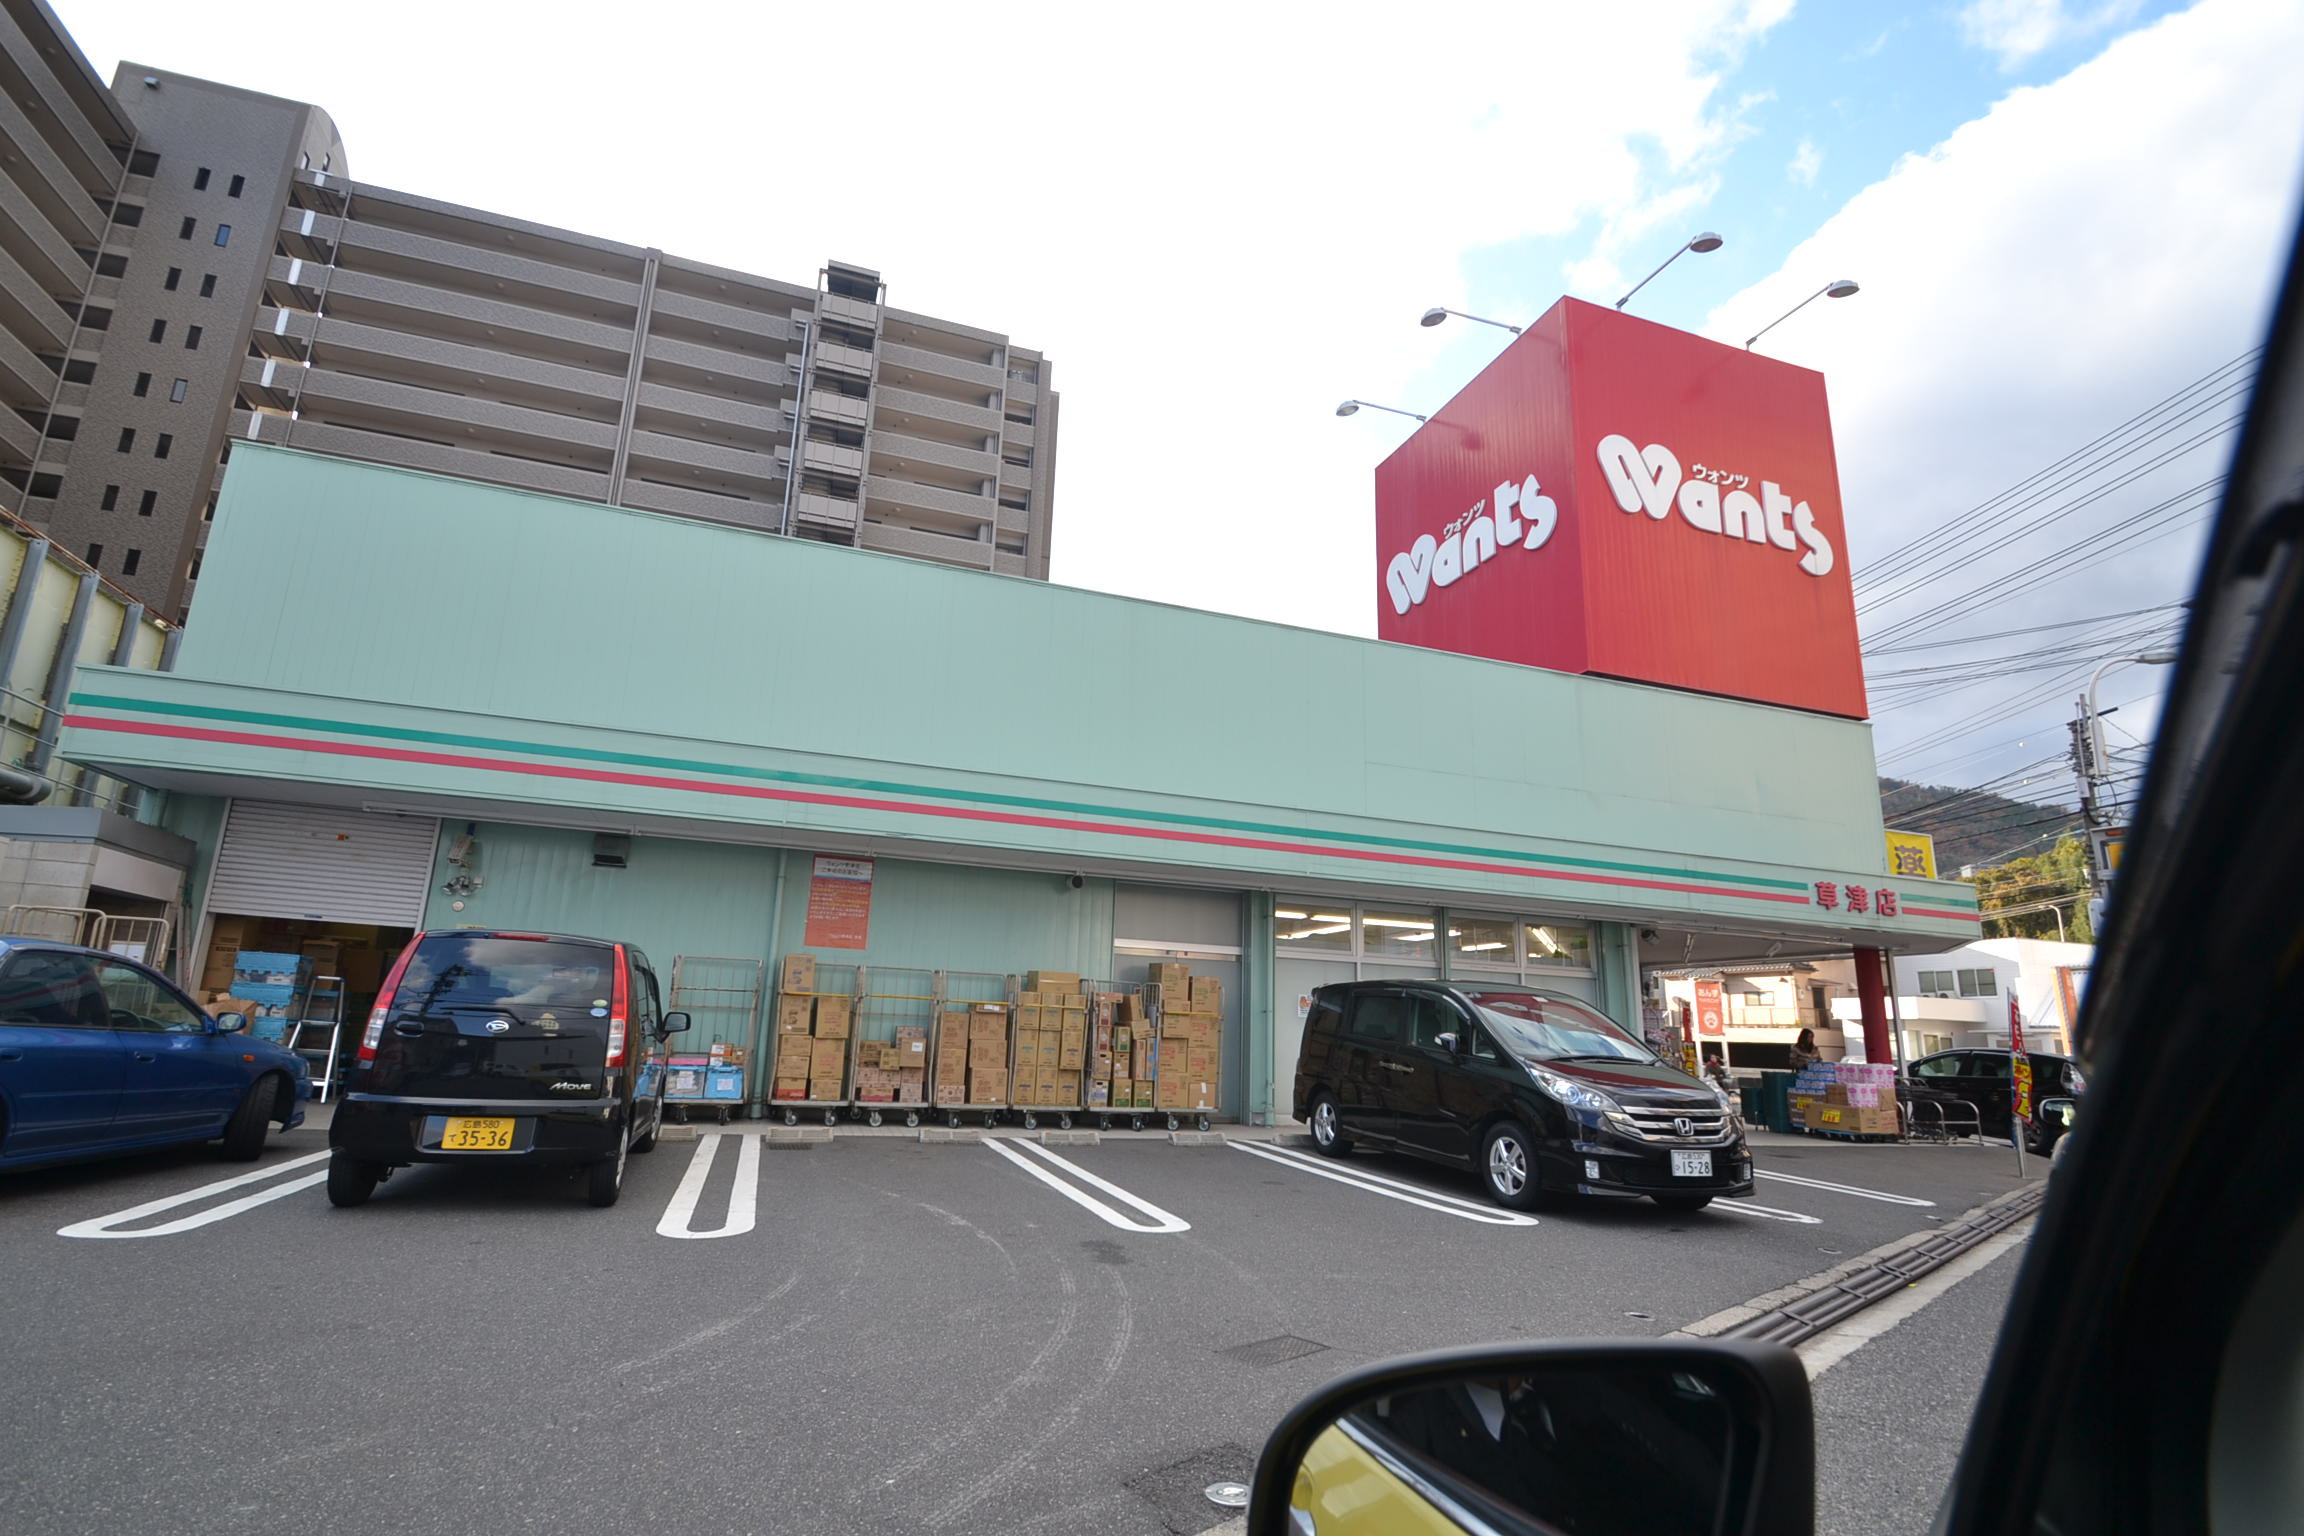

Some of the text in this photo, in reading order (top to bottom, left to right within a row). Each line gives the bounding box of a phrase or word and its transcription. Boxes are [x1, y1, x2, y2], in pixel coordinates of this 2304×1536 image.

[1692, 463, 1750, 489] ウォンツ
[1443, 499, 1486, 539] ウォンツ
[1596, 434, 1834, 577] Wants
[1386, 474, 1558, 615] Wants
[1815, 881, 1897, 916] 草津店
[549, 1081, 592, 1090] MOVE
[457, 1130, 509, 1147] 35-36
[1682, 1161, 1710, 1174] 15-28
